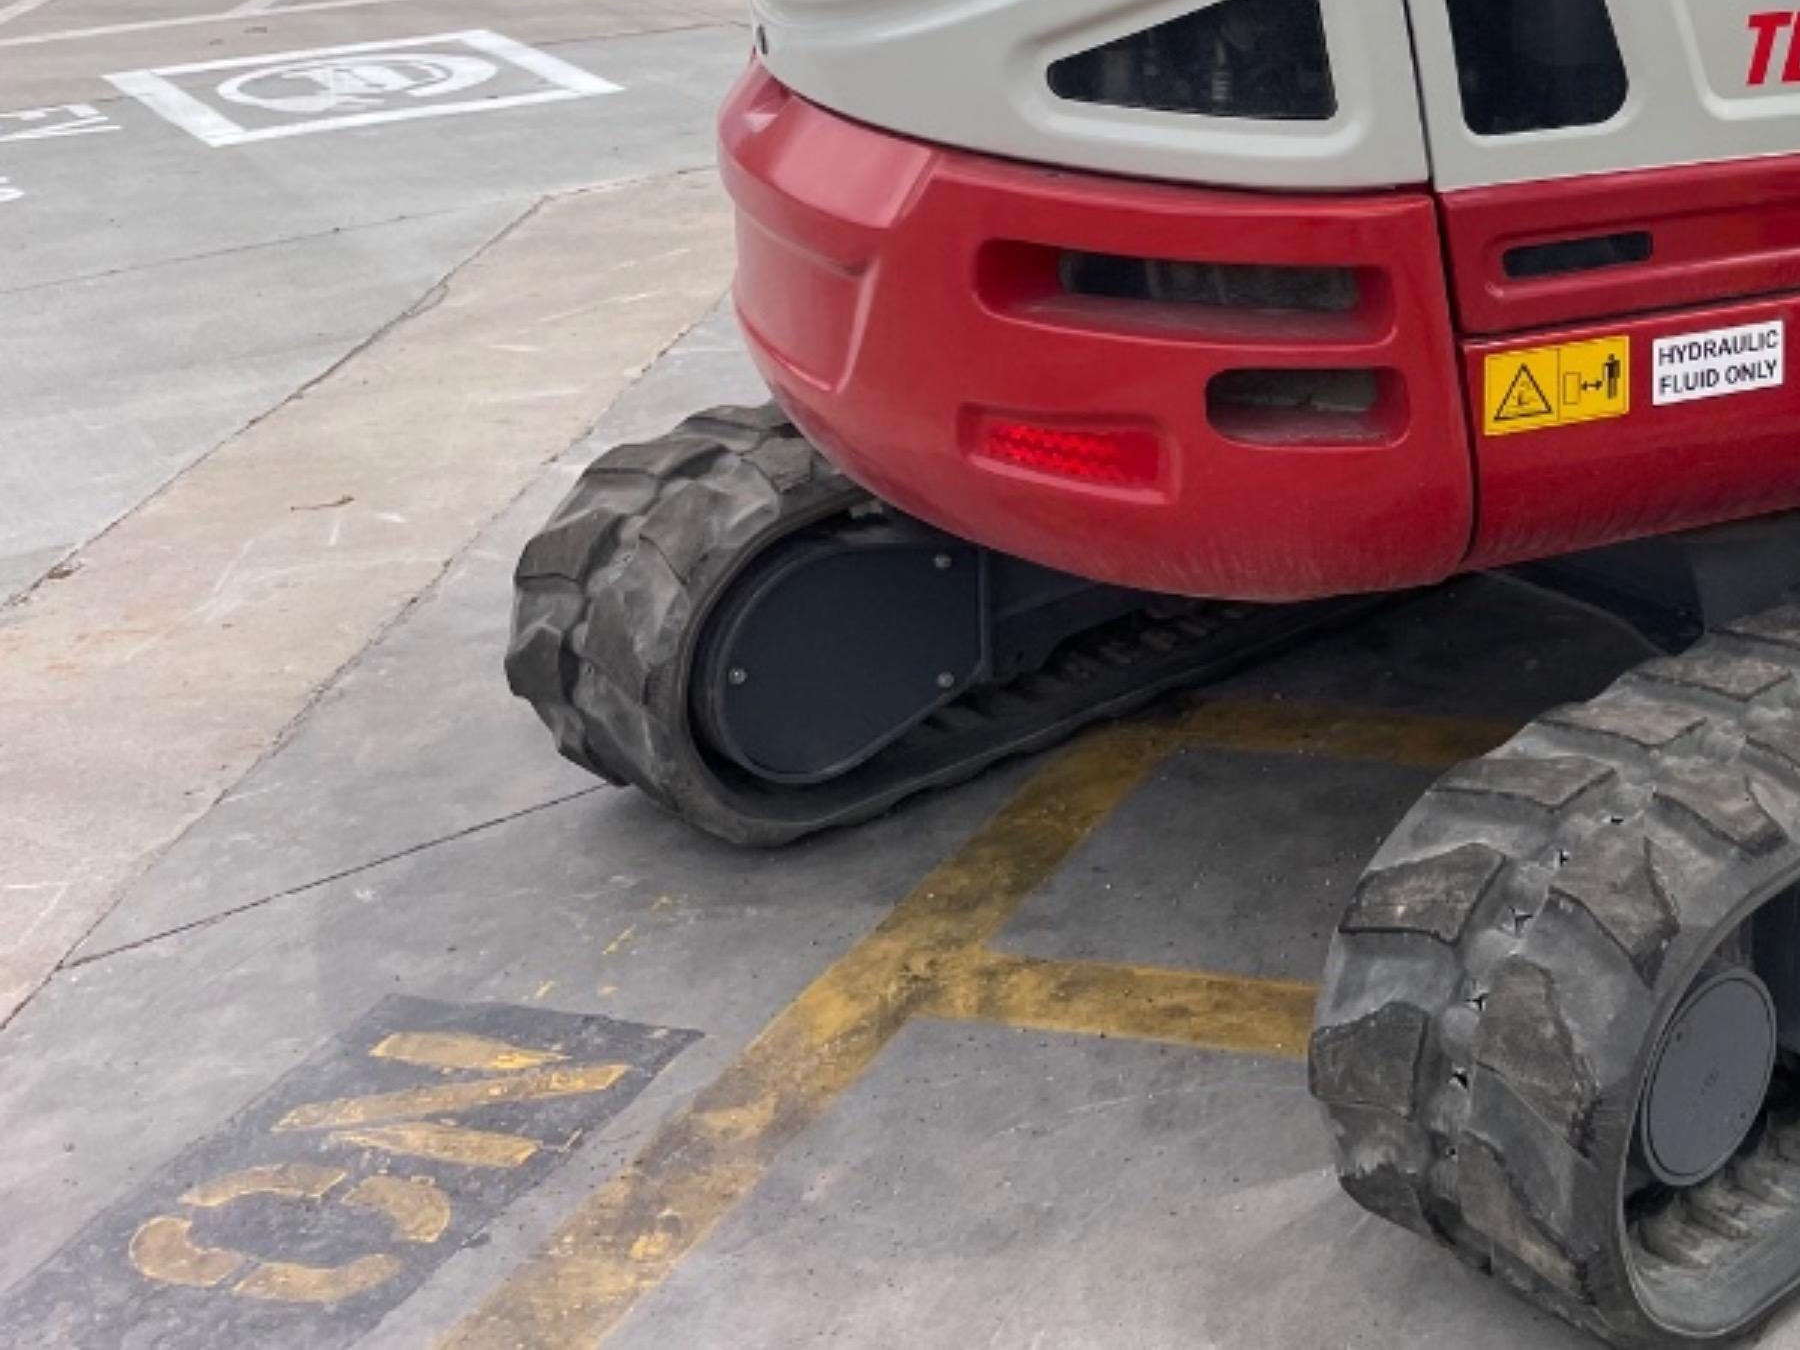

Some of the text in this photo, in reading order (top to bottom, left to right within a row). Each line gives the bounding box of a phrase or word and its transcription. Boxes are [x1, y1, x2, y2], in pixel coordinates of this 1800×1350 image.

[1659, 329, 1778, 366] HYDRAULIC
[1659, 358, 1777, 396] FLUID ONLY
